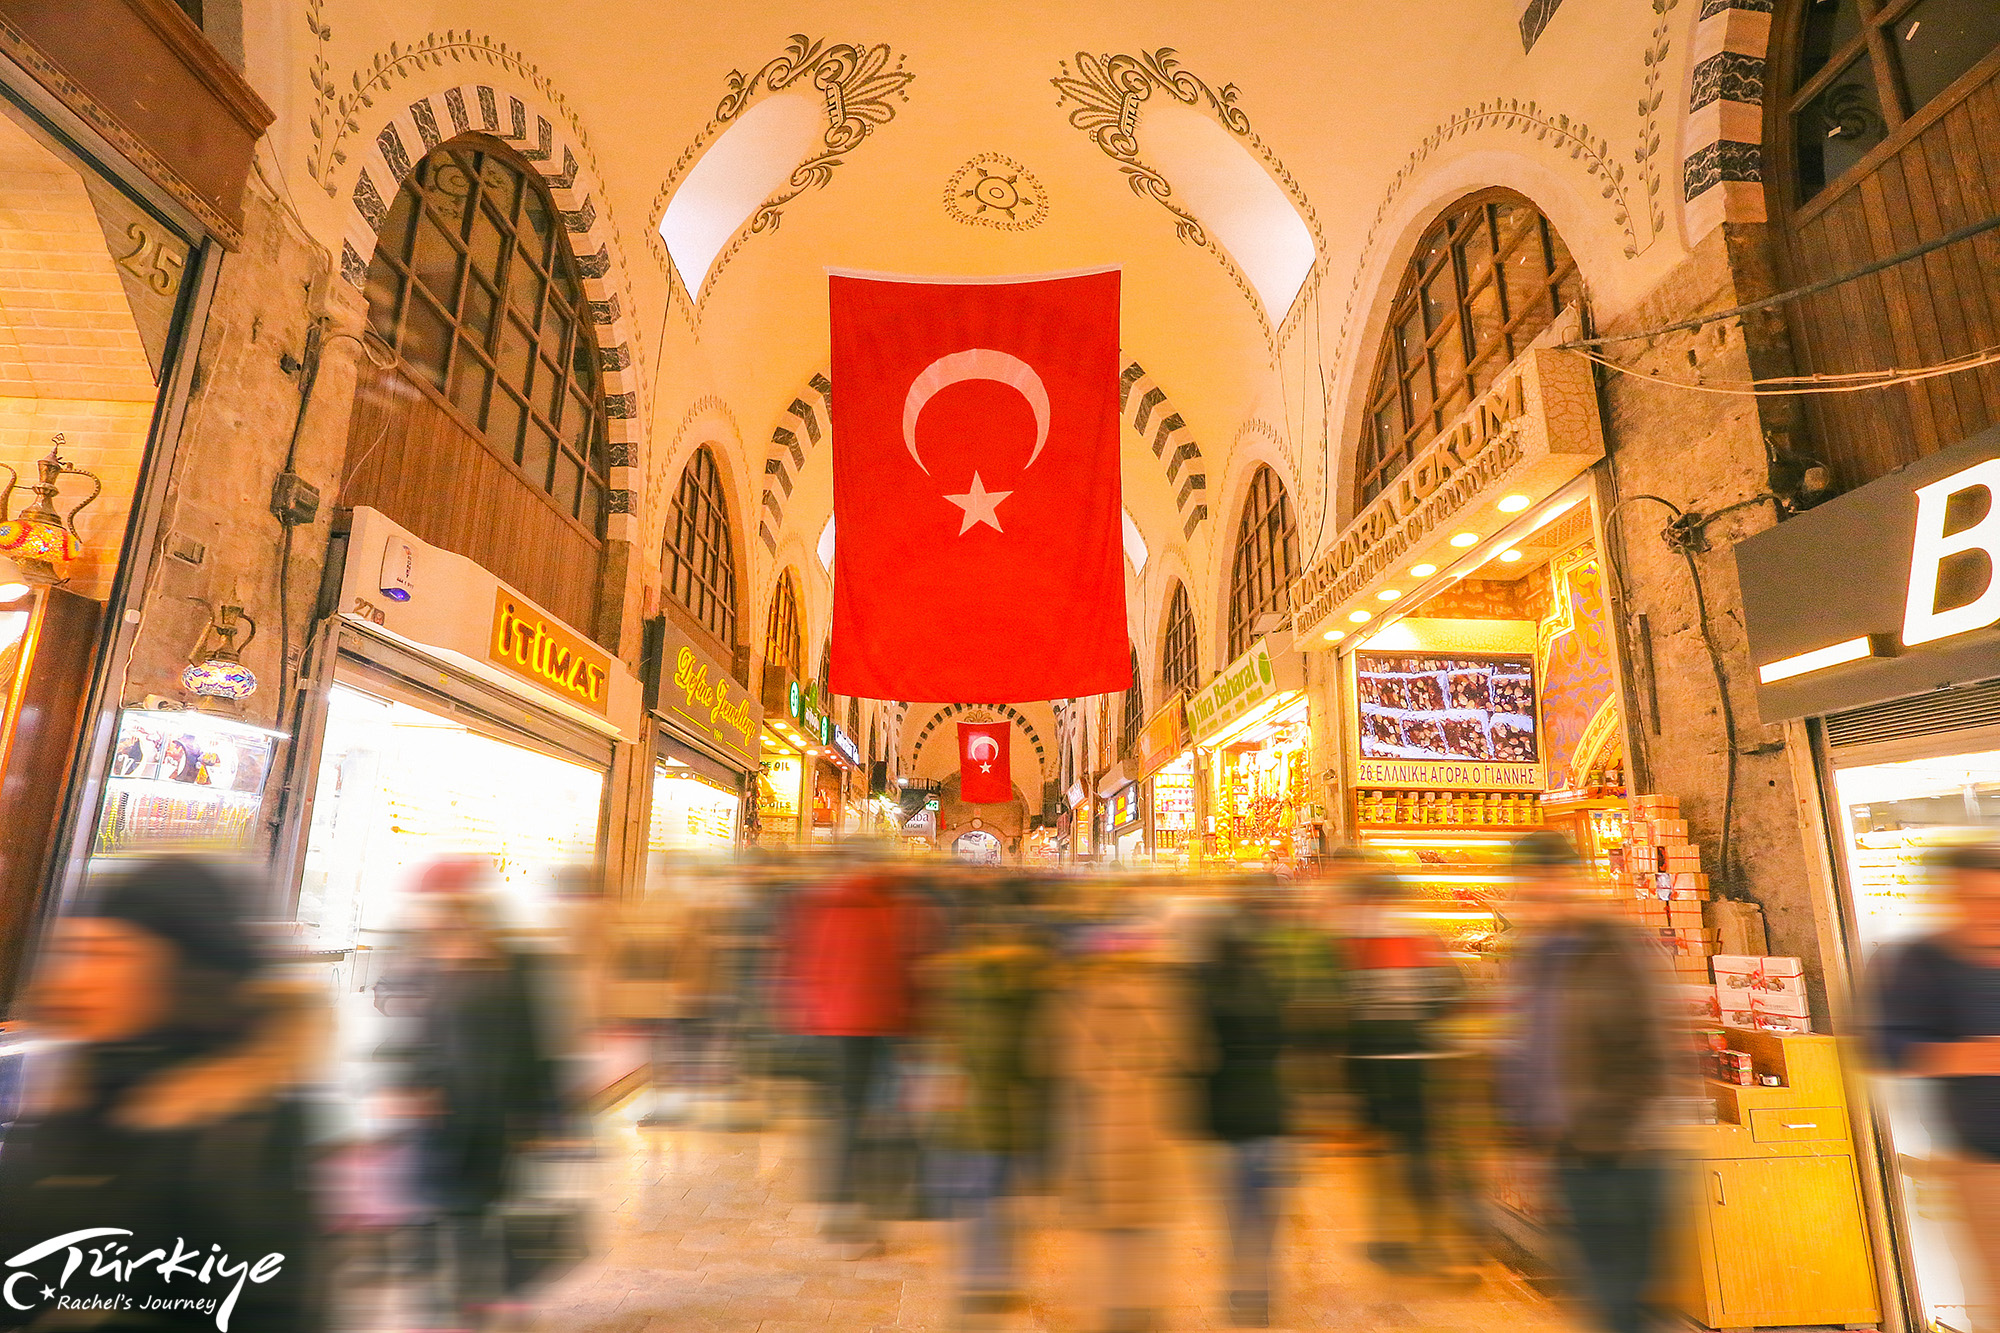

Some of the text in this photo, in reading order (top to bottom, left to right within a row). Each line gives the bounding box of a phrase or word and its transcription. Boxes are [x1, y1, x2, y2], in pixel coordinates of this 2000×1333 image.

[119, 223, 183, 296] 25
[1290, 375, 1525, 613] MARMARA LOKUM
[674, 646, 713, 707] Defne
[710, 678, 757, 747] Jewellery
[1194, 696, 1215, 724] Hira
[1213, 654, 1258, 710] Baharat
[774, 762, 790, 771] OIL
[1360, 765, 1373, 780] 26
[1431, 766, 1470, 784] ΑΓΟΡΑ
[1472, 767, 1481, 784] Ο
[1484, 766, 1535, 784] ΓΙΑΝΝΗΣ
